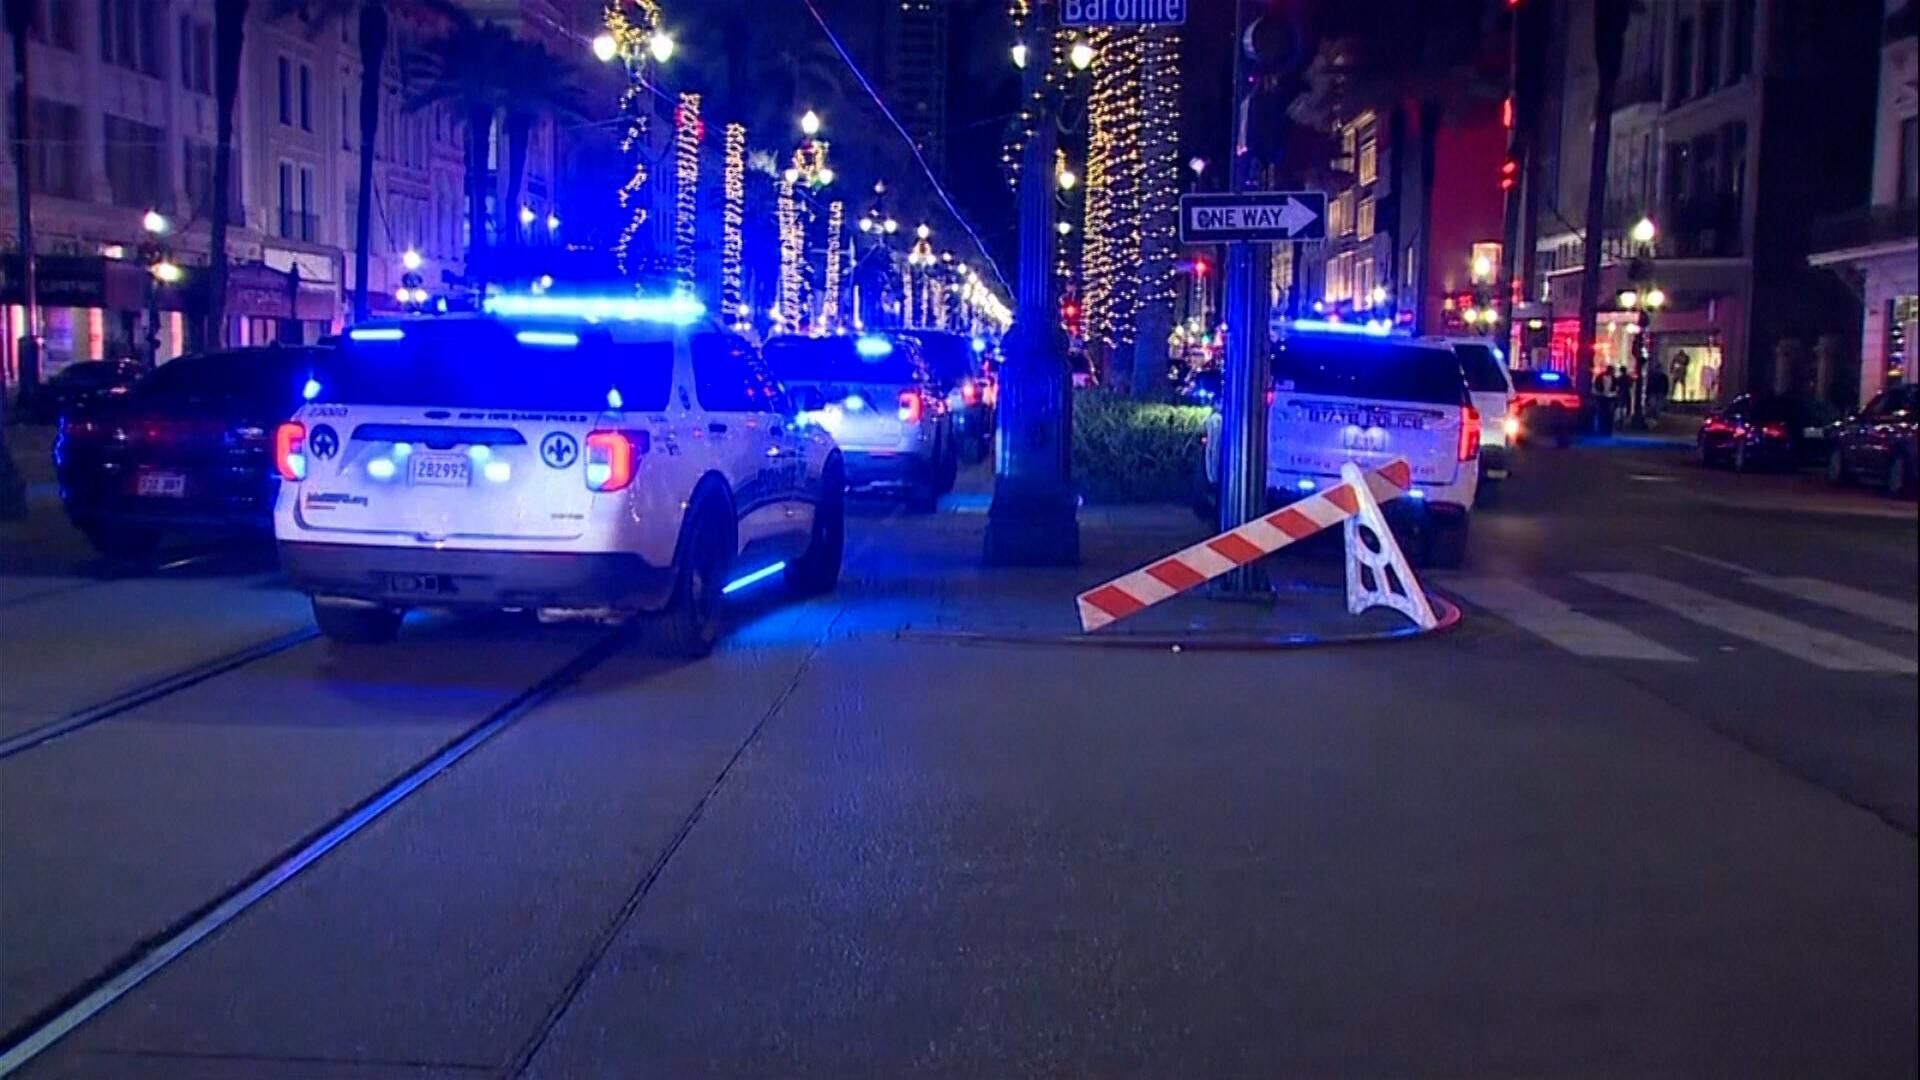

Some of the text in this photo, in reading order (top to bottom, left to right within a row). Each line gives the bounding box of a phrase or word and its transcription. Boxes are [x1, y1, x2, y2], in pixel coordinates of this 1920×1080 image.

[1065, 0, 1179, 20] Baronne
[1197, 207, 1283, 228] ONE WAY
